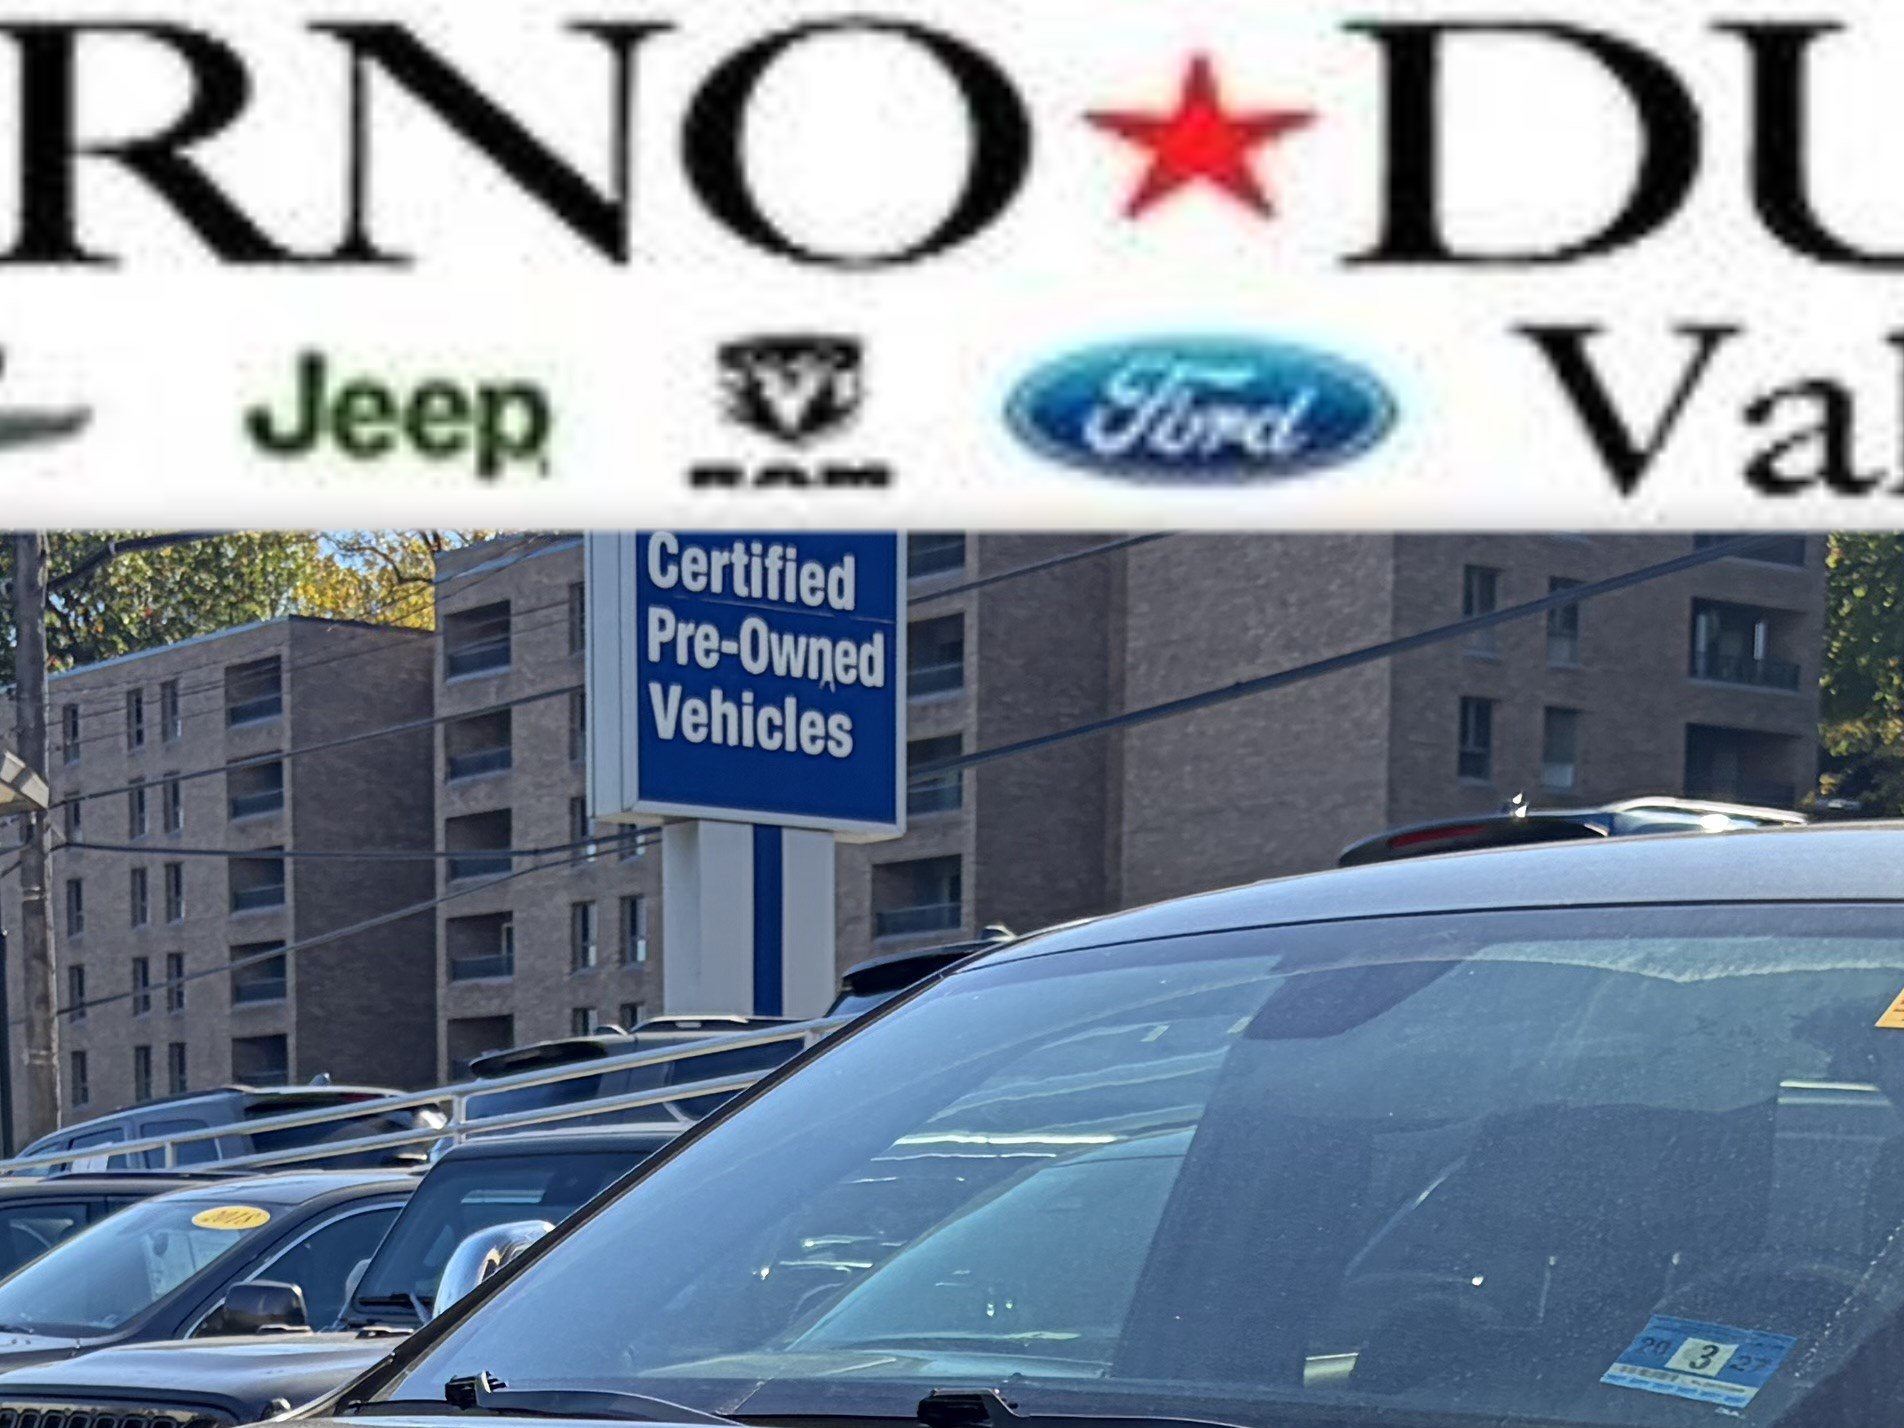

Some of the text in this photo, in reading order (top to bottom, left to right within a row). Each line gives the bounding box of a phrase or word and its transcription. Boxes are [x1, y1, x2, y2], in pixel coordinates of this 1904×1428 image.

[647, 529, 856, 612] Certified
[647, 603, 886, 689] Pre-Owned
[648, 681, 854, 759] Vehicles
[1688, 1343, 1720, 1370] 3
